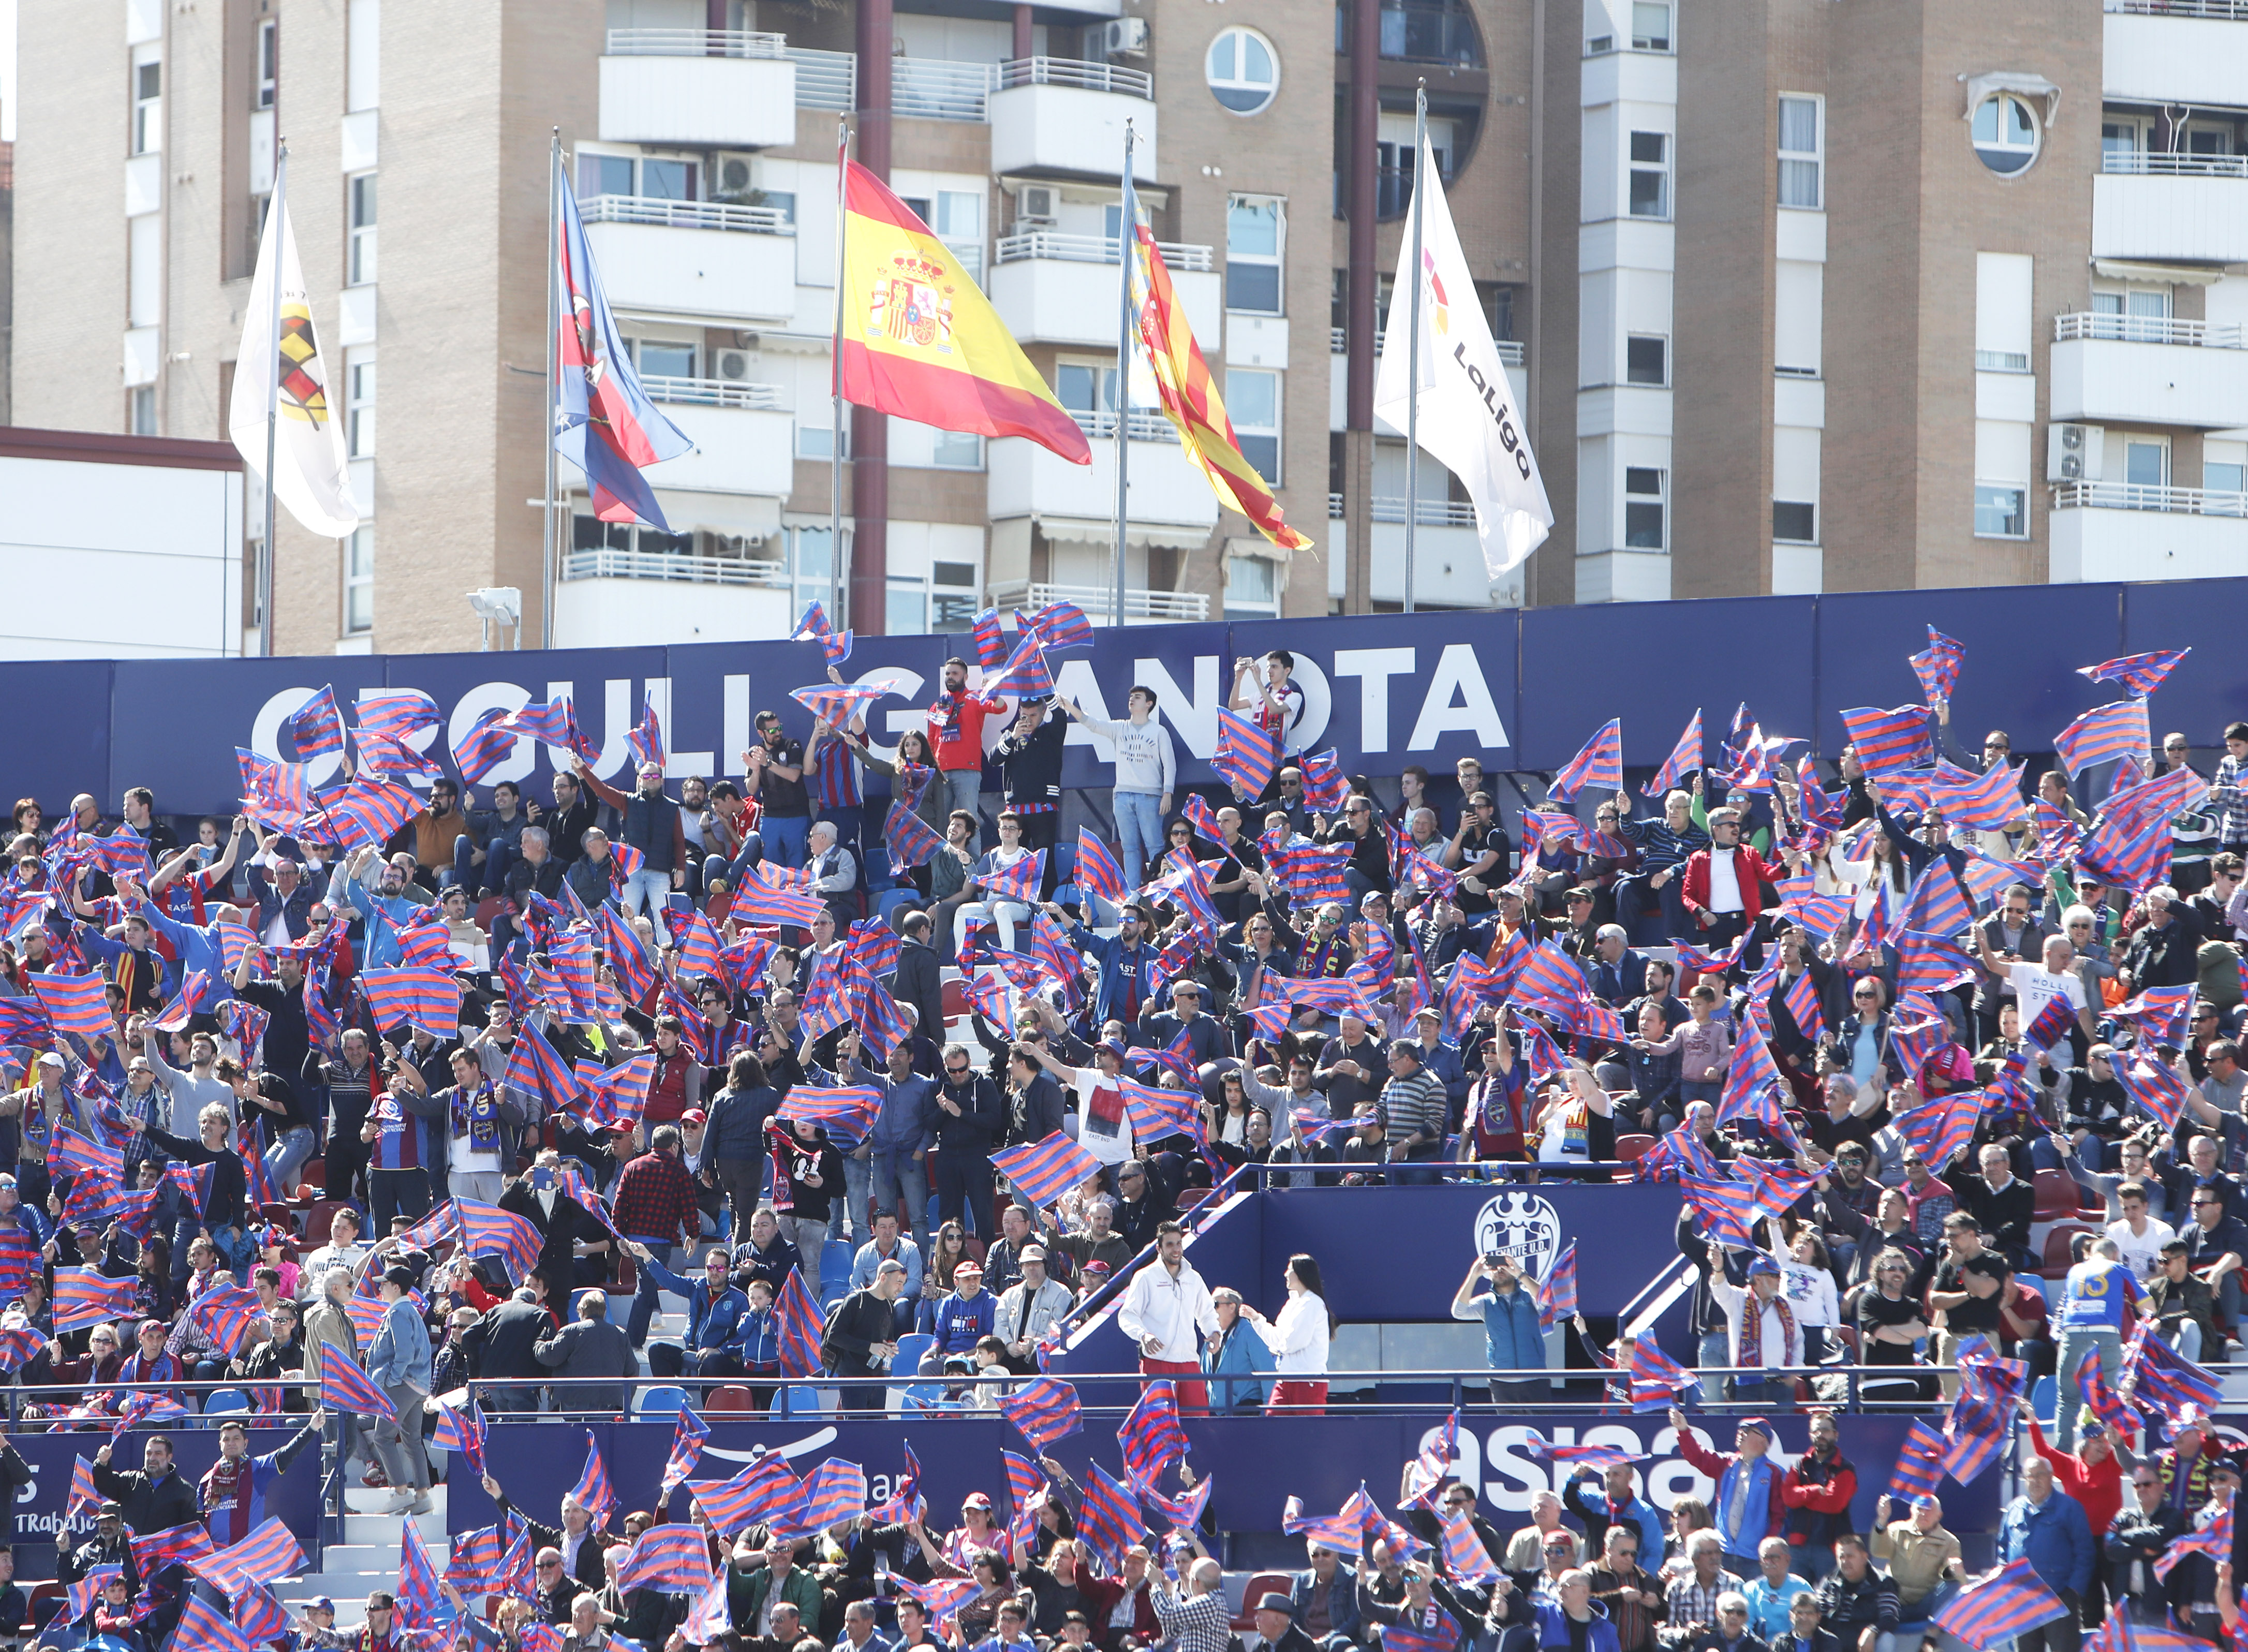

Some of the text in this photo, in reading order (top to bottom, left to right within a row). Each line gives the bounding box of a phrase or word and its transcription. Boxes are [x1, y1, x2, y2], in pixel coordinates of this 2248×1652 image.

[1454, 342, 1530, 481] LaLiga
[1529, 1241, 1547, 1253] U.D.
[1419, 1424, 1717, 1512] asisa
